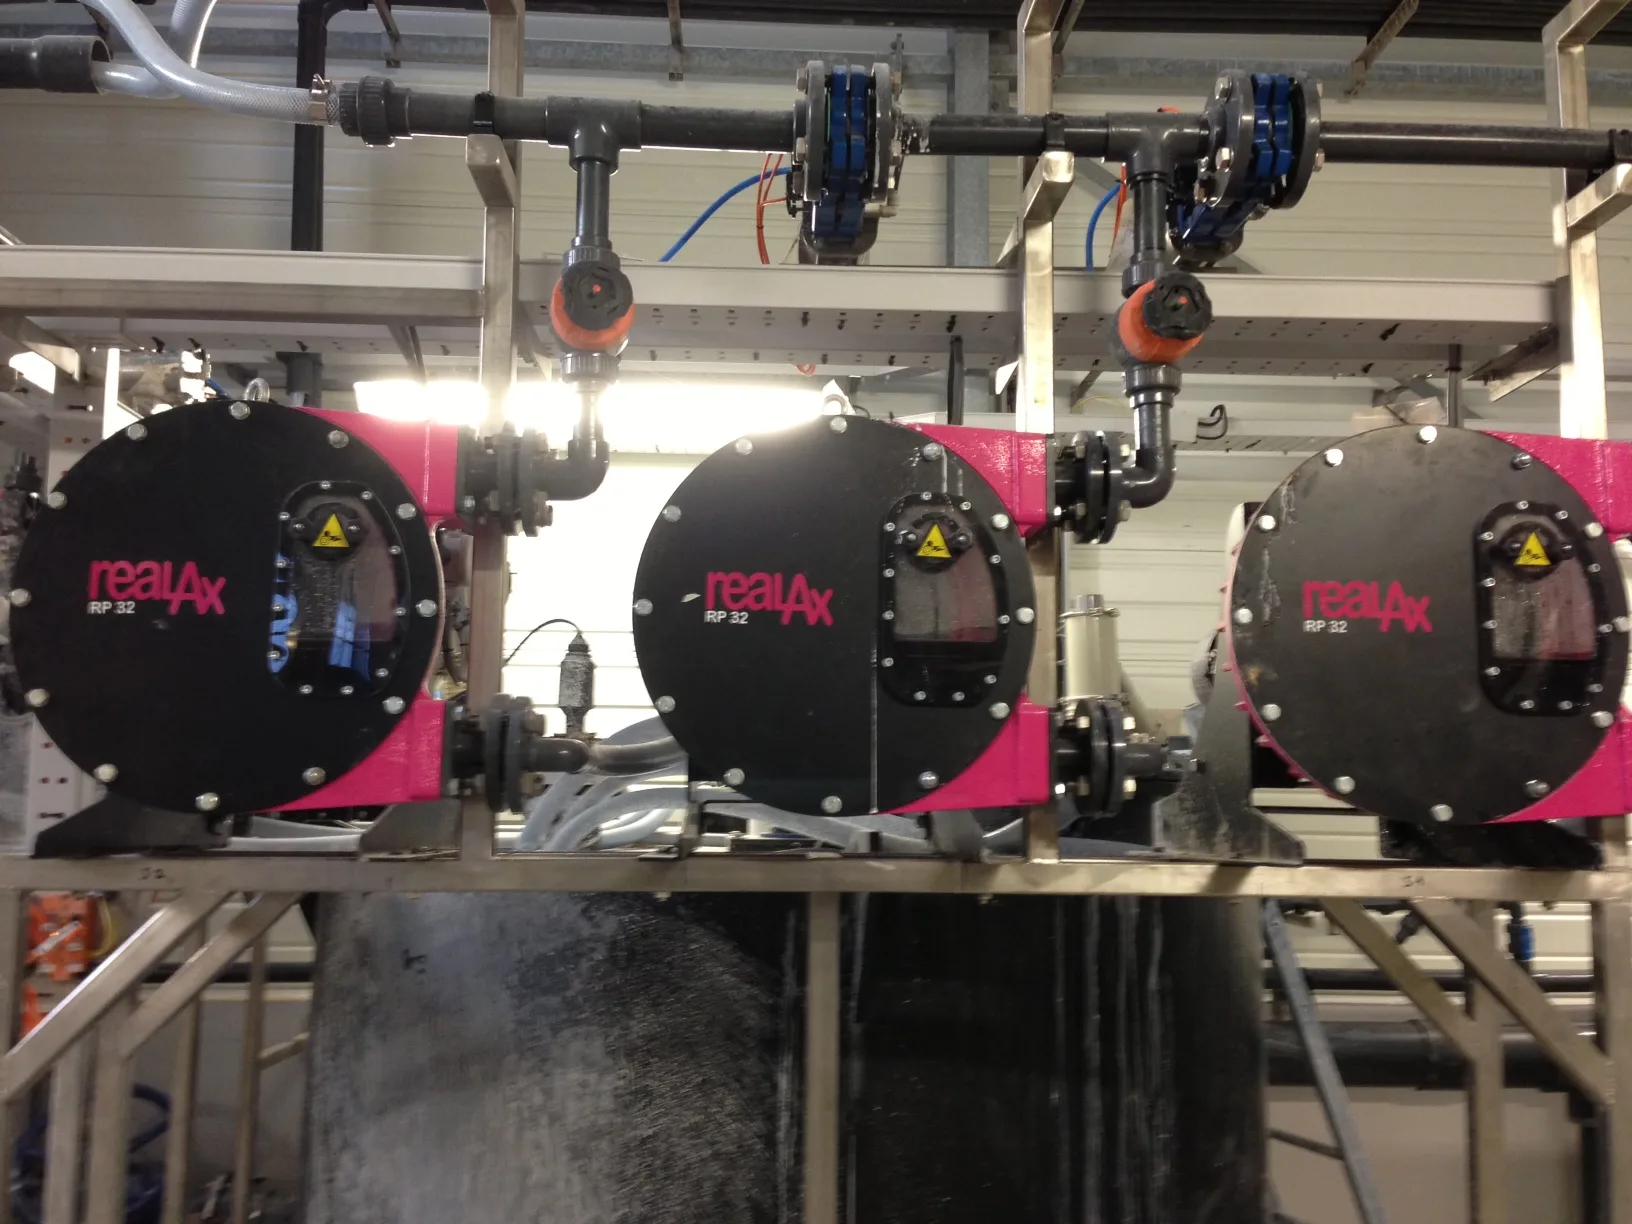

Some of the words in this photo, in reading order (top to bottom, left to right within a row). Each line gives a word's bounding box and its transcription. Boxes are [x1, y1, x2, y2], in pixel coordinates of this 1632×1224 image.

[87, 601, 112, 614] RP
[114, 601, 136, 614] 32
[704, 610, 727, 623] RP
[729, 611, 749, 624] 32
[1303, 620, 1326, 632] RP
[1328, 620, 1348, 633] 32
